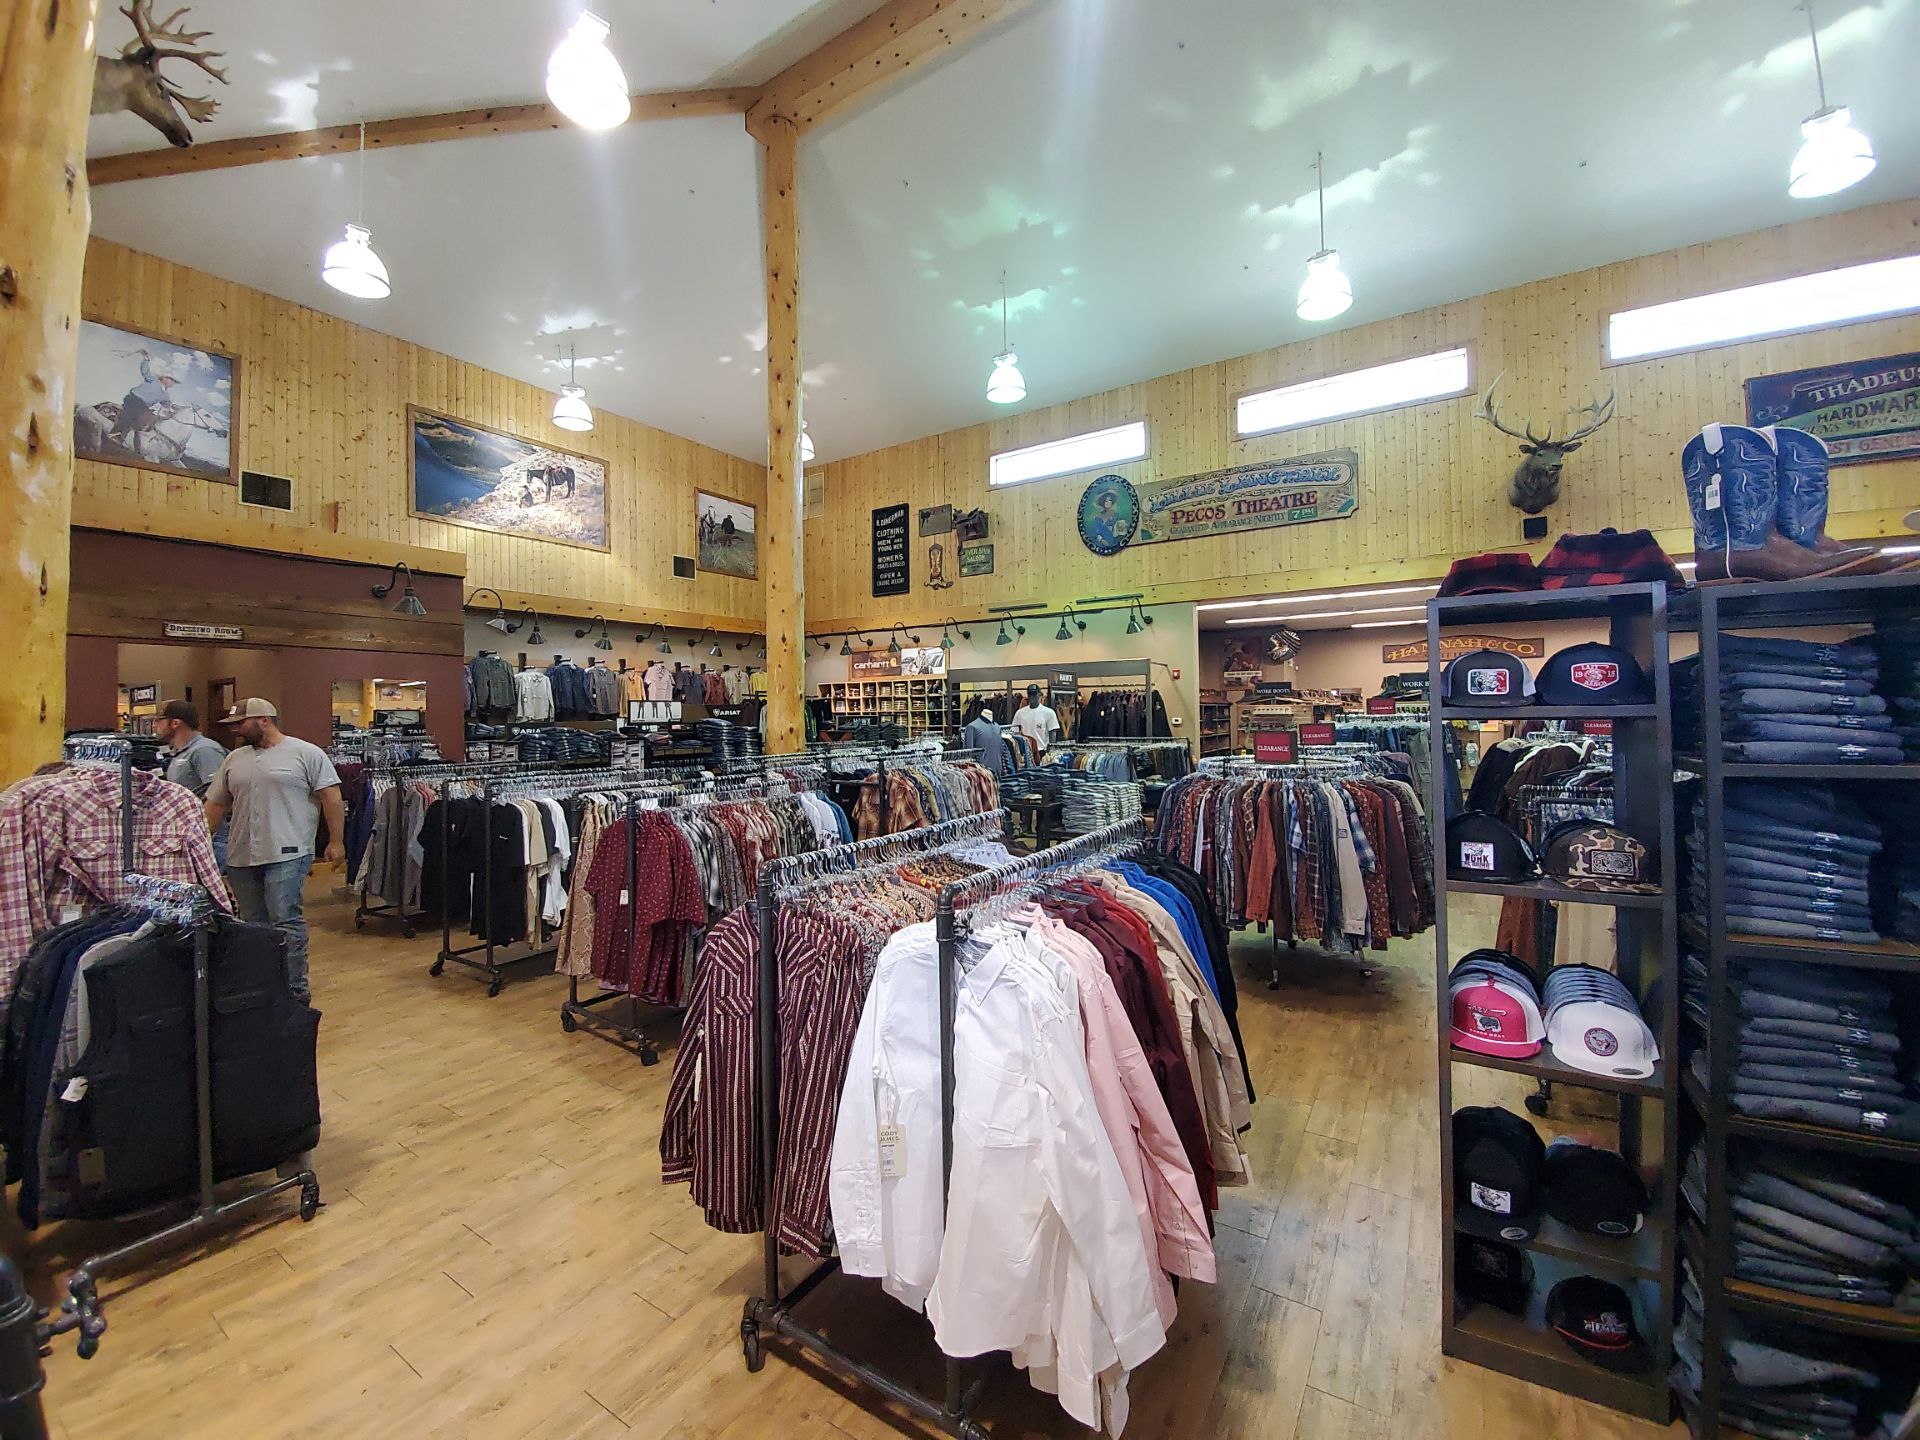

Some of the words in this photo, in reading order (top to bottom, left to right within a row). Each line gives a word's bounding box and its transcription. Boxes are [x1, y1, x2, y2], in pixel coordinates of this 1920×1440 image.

[1808, 367, 1920, 402] THADEU
[1170, 504, 1226, 525] PECOS
[1232, 490, 1318, 516] THEATRE
[1253, 511, 1286, 525] NIGHTLY
[1291, 510, 1299, 519] 7
[1301, 507, 1315, 516] PM
[876, 526, 905, 538] CLOTHING
[877, 552, 904, 563] WOMEN'S
[880, 572, 896, 580] OPEN
[169, 625, 211, 634] DRESSING
[214, 627, 238, 635] ROOM
[1486, 639, 1501, 649] &
[1502, 641, 1538, 656] CO.
[853, 657, 890, 670] carhartt
[1402, 680, 1423, 688] WORK
